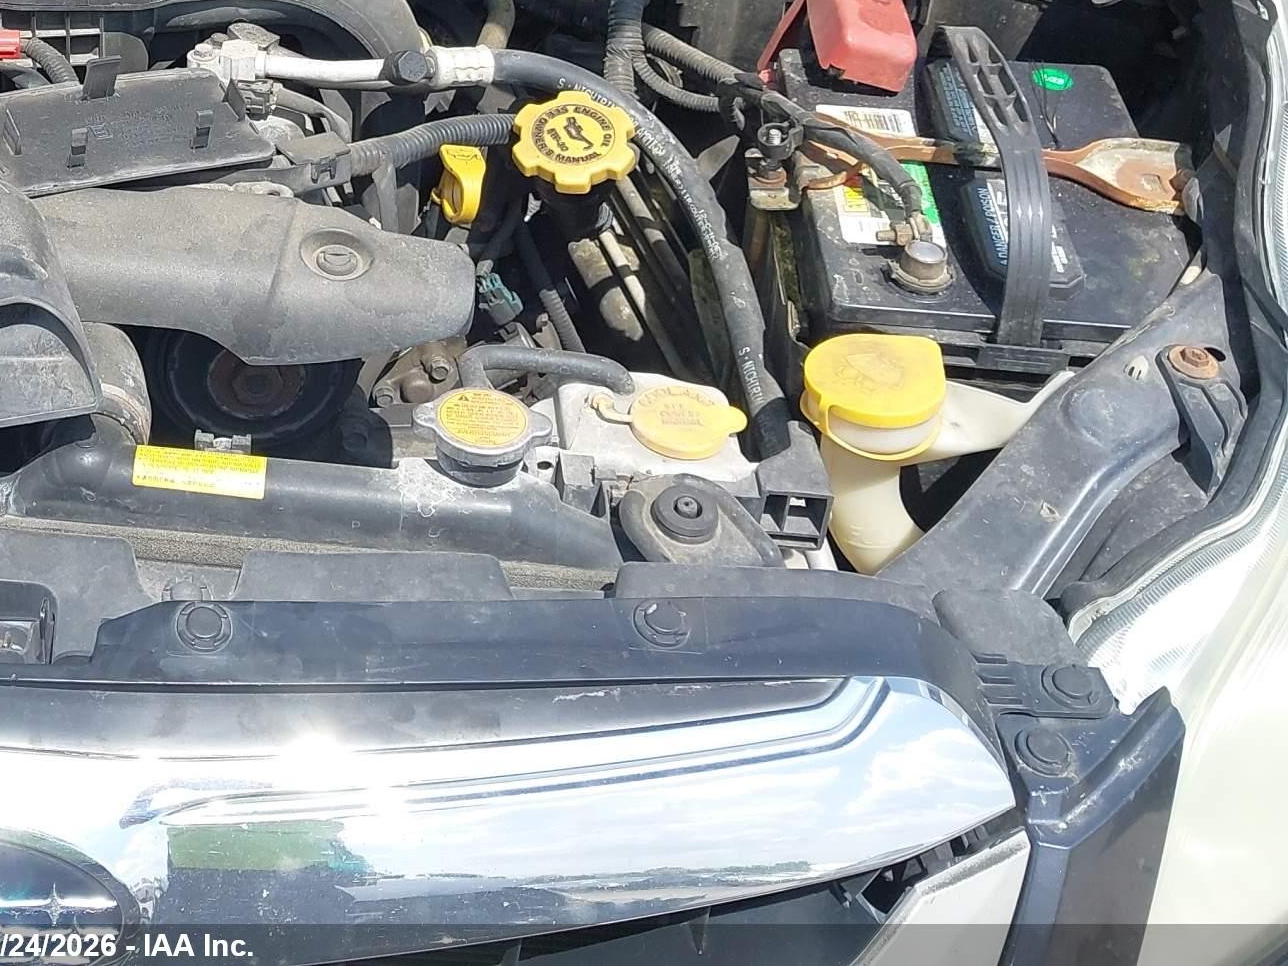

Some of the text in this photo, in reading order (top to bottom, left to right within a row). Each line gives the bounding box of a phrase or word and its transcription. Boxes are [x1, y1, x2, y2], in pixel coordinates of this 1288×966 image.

[573, 106, 613, 147] ENGINE OIL
[555, 152, 602, 164] MANUAL
